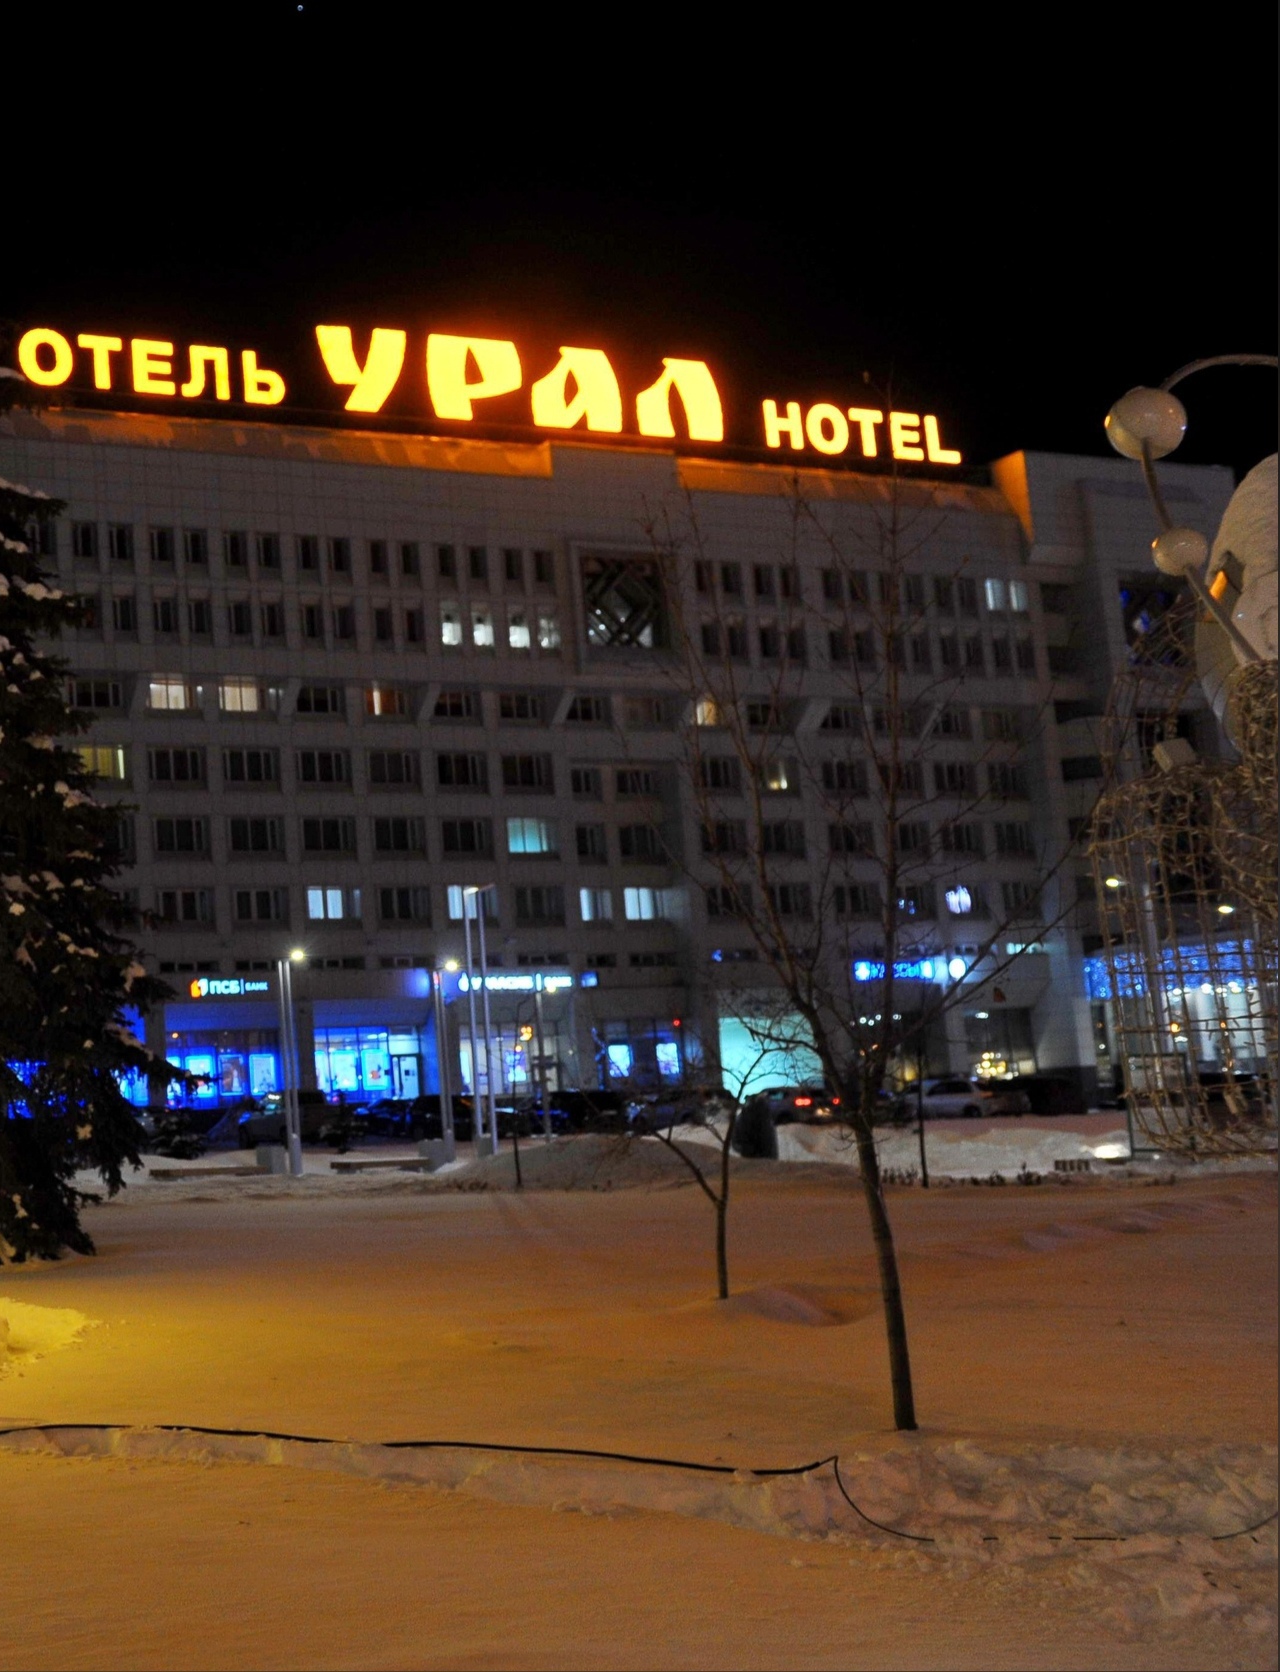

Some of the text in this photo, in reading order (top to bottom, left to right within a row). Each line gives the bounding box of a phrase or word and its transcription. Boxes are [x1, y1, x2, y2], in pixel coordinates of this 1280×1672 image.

[18, 324, 962, 465] ОТЕЛЬ УРАЛ HOTEL
[209, 979, 241, 995] ПСБ
